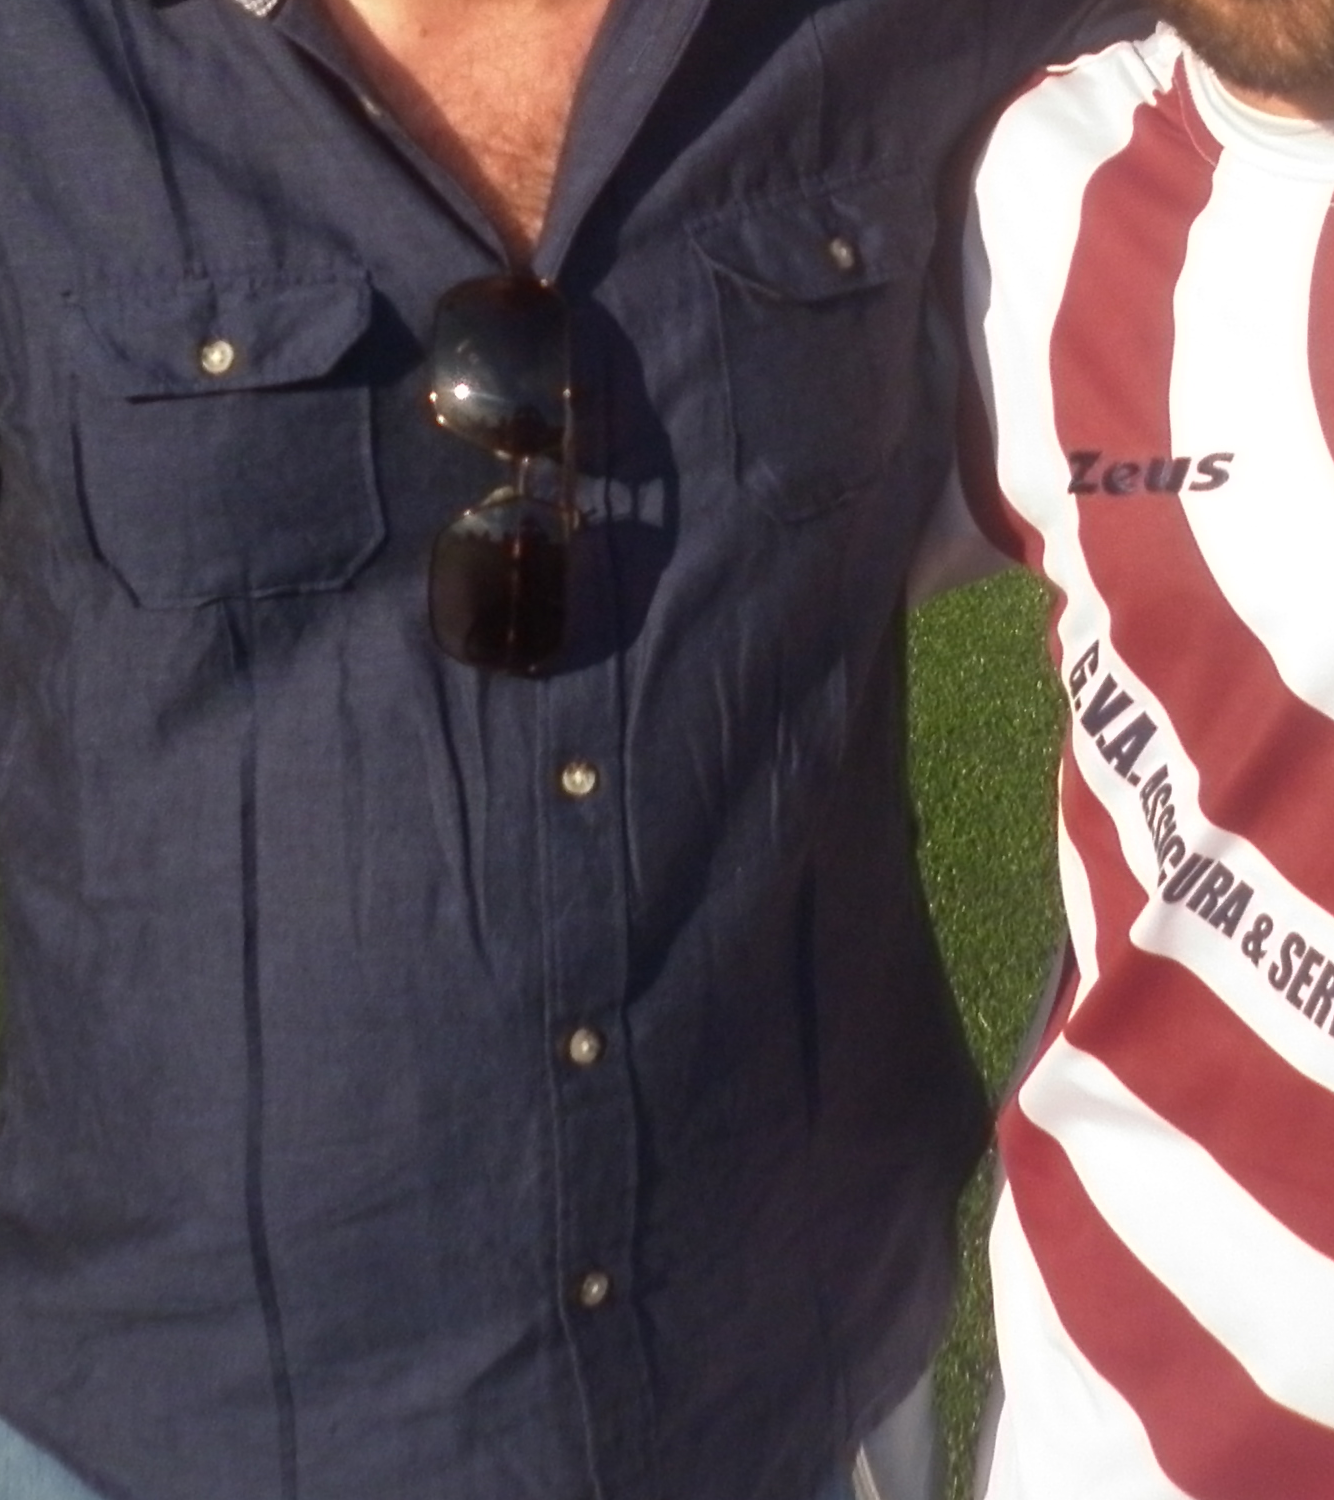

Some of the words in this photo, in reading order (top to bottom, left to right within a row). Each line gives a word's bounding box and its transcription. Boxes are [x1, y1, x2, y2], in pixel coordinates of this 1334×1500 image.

[1067, 451, 1235, 495] Zeus
[1069, 639, 1158, 787] G.V.A.
[1139, 763, 1255, 940] ASSICURA
[1241, 912, 1274, 968] &
